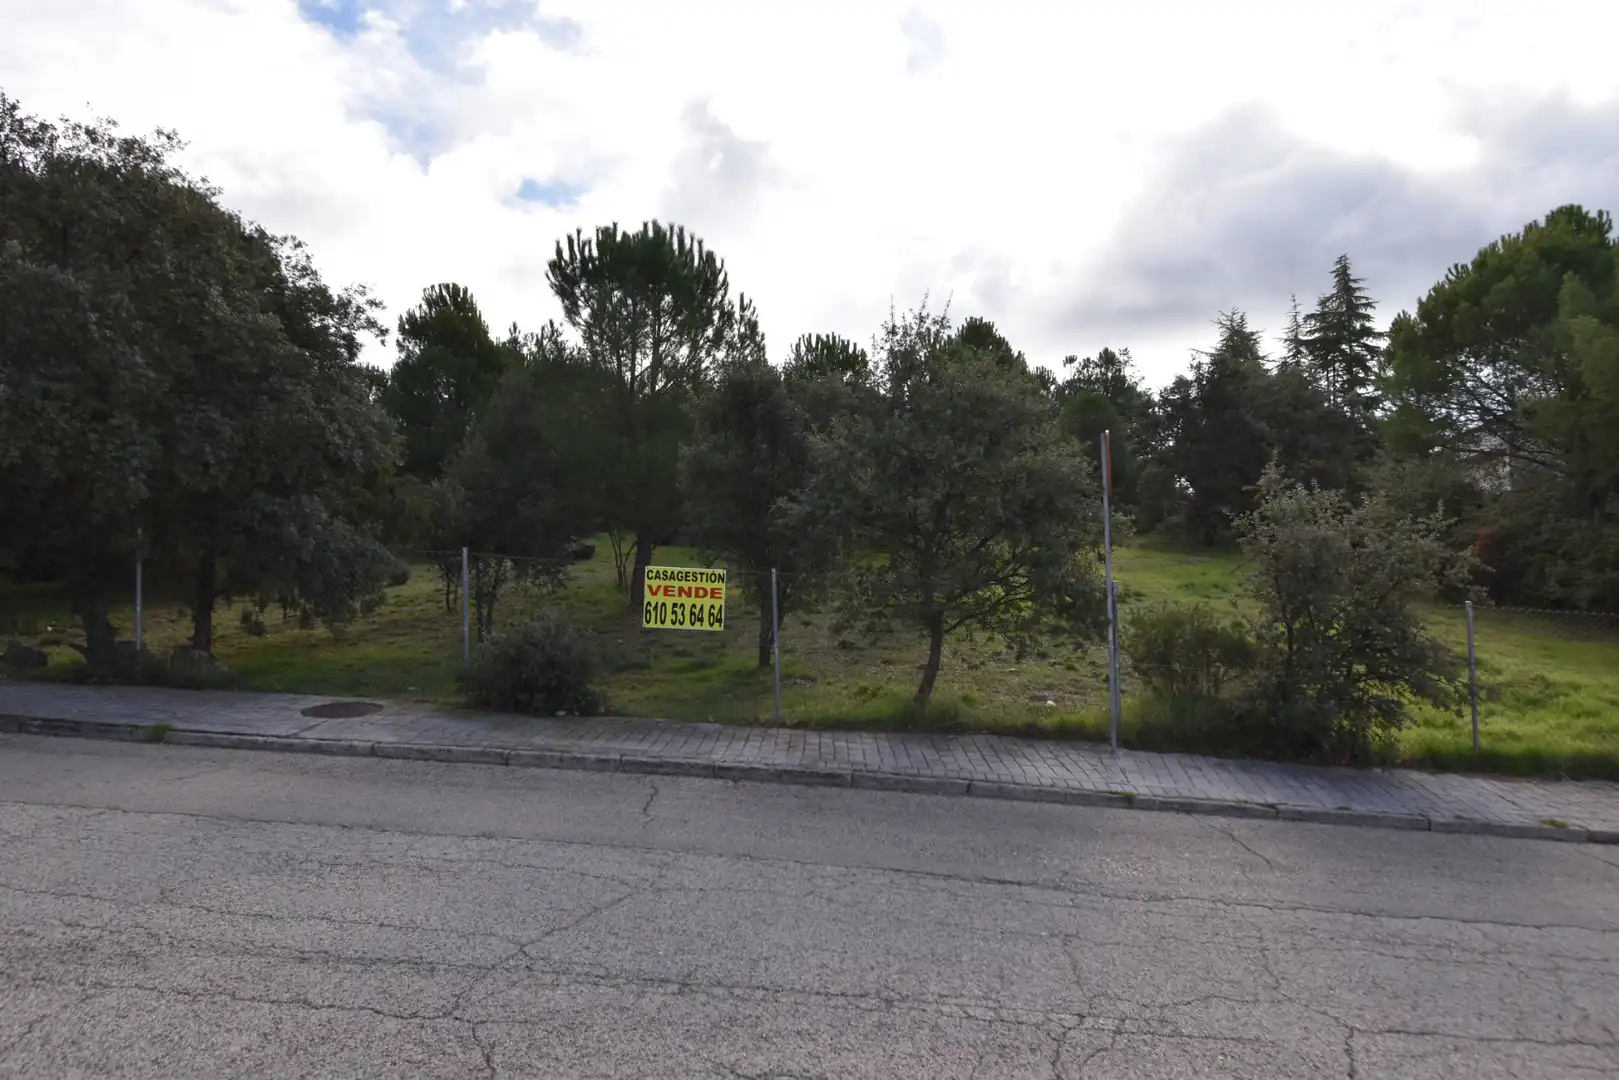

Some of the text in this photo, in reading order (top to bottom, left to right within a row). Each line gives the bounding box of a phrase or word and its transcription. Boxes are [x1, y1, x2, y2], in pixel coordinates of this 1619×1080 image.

[647, 584, 723, 599] VENDE
[645, 601, 723, 628] 610 53 64 64
